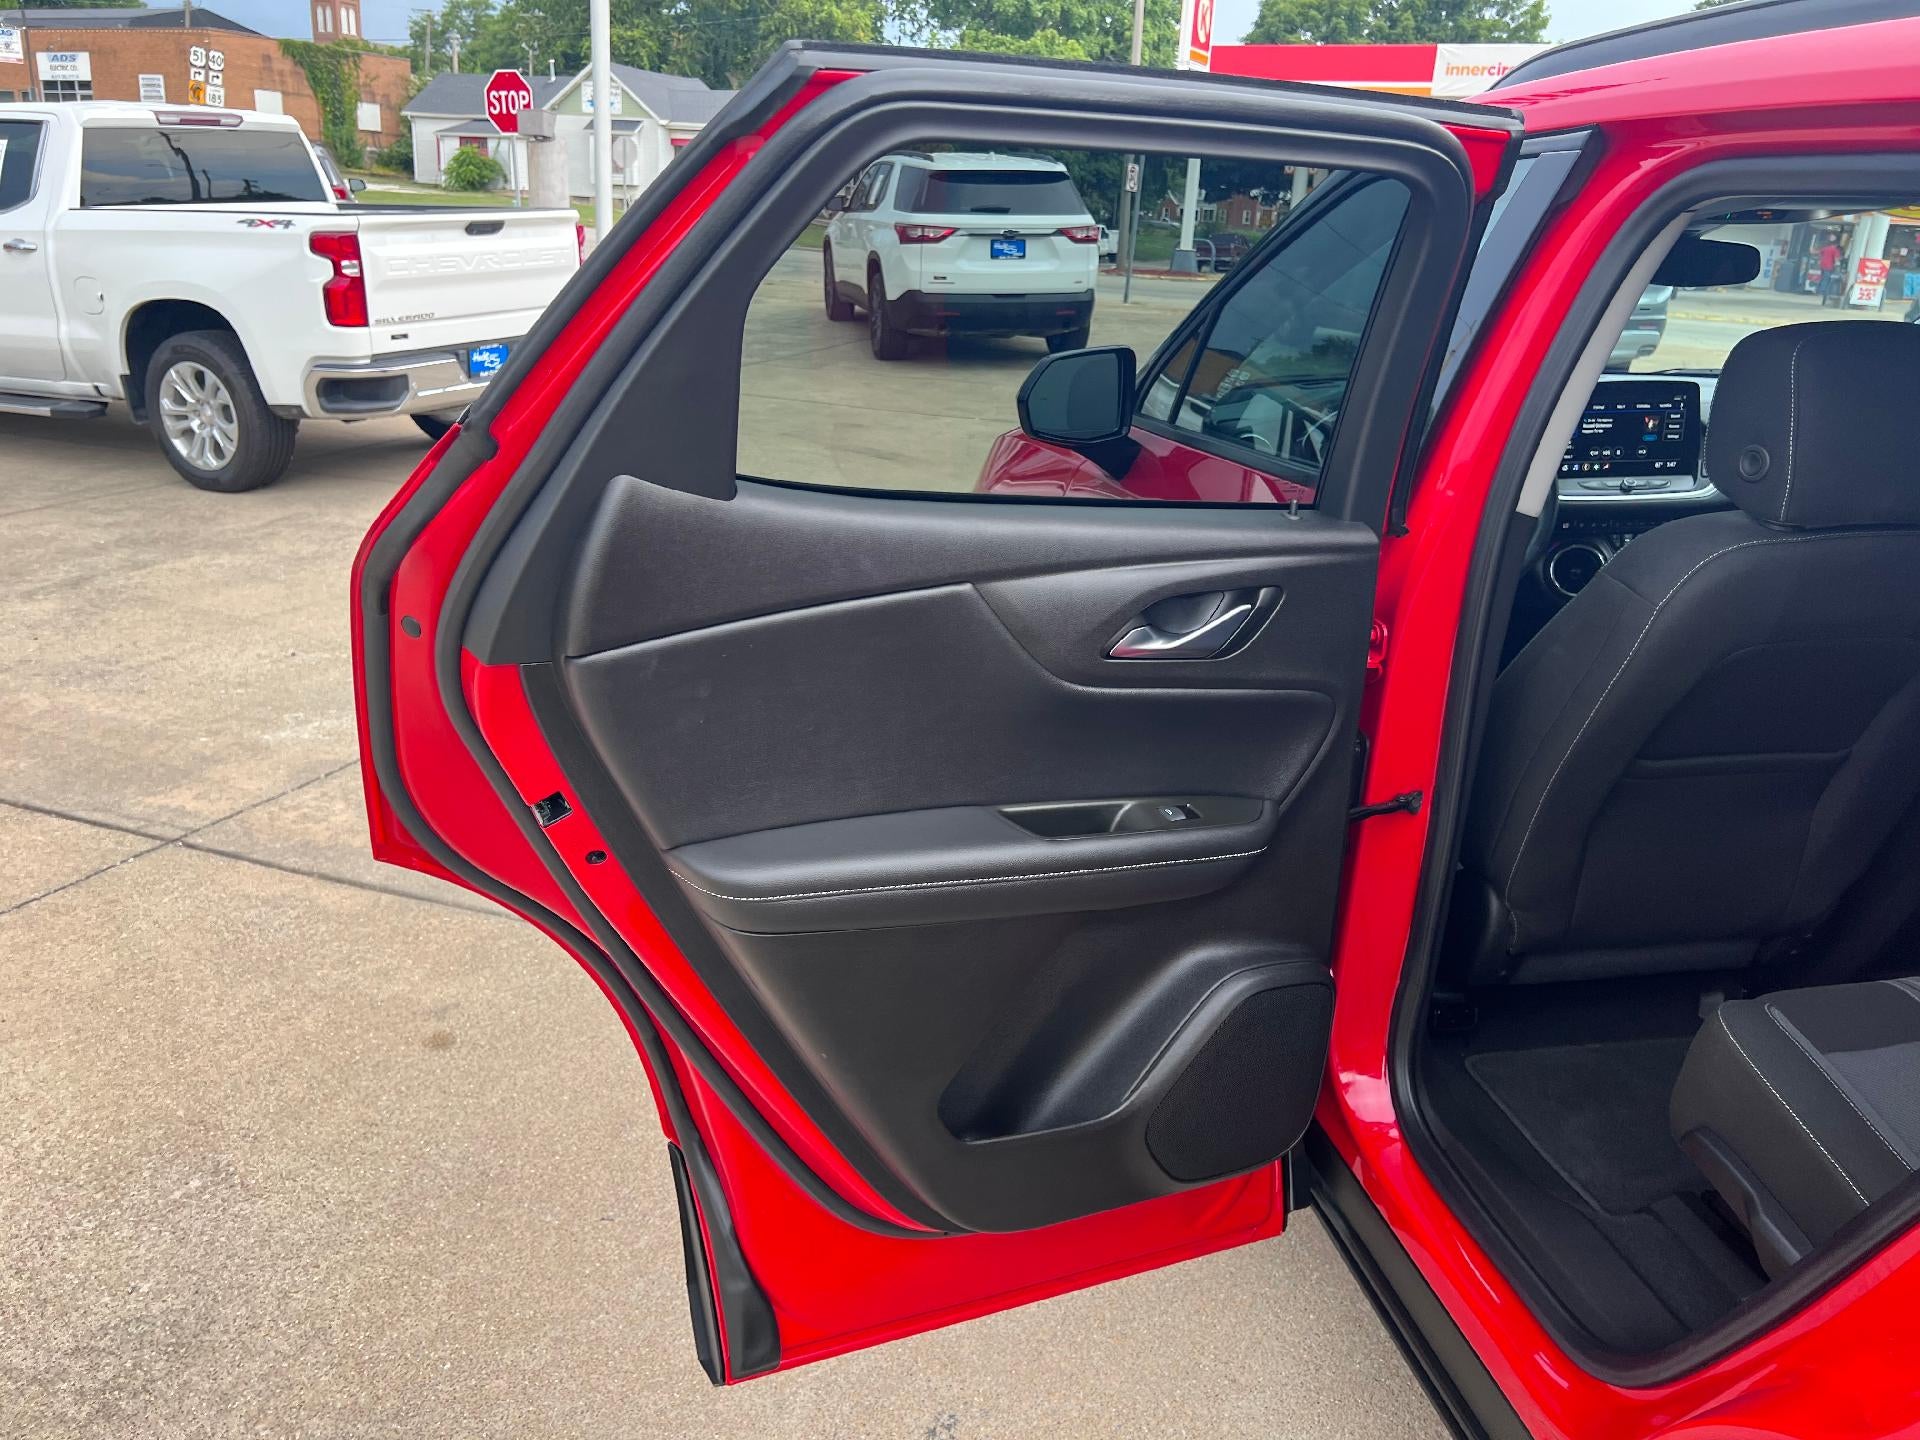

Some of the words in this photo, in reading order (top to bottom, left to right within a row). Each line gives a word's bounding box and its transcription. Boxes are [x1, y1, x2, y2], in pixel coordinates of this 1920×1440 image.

[51, 54, 77, 62] ADS
[193, 49, 204, 62] 51
[1446, 62, 1515, 76] innercir
[489, 90, 530, 115] STOP
[386, 248, 571, 276] CHEVROLET
